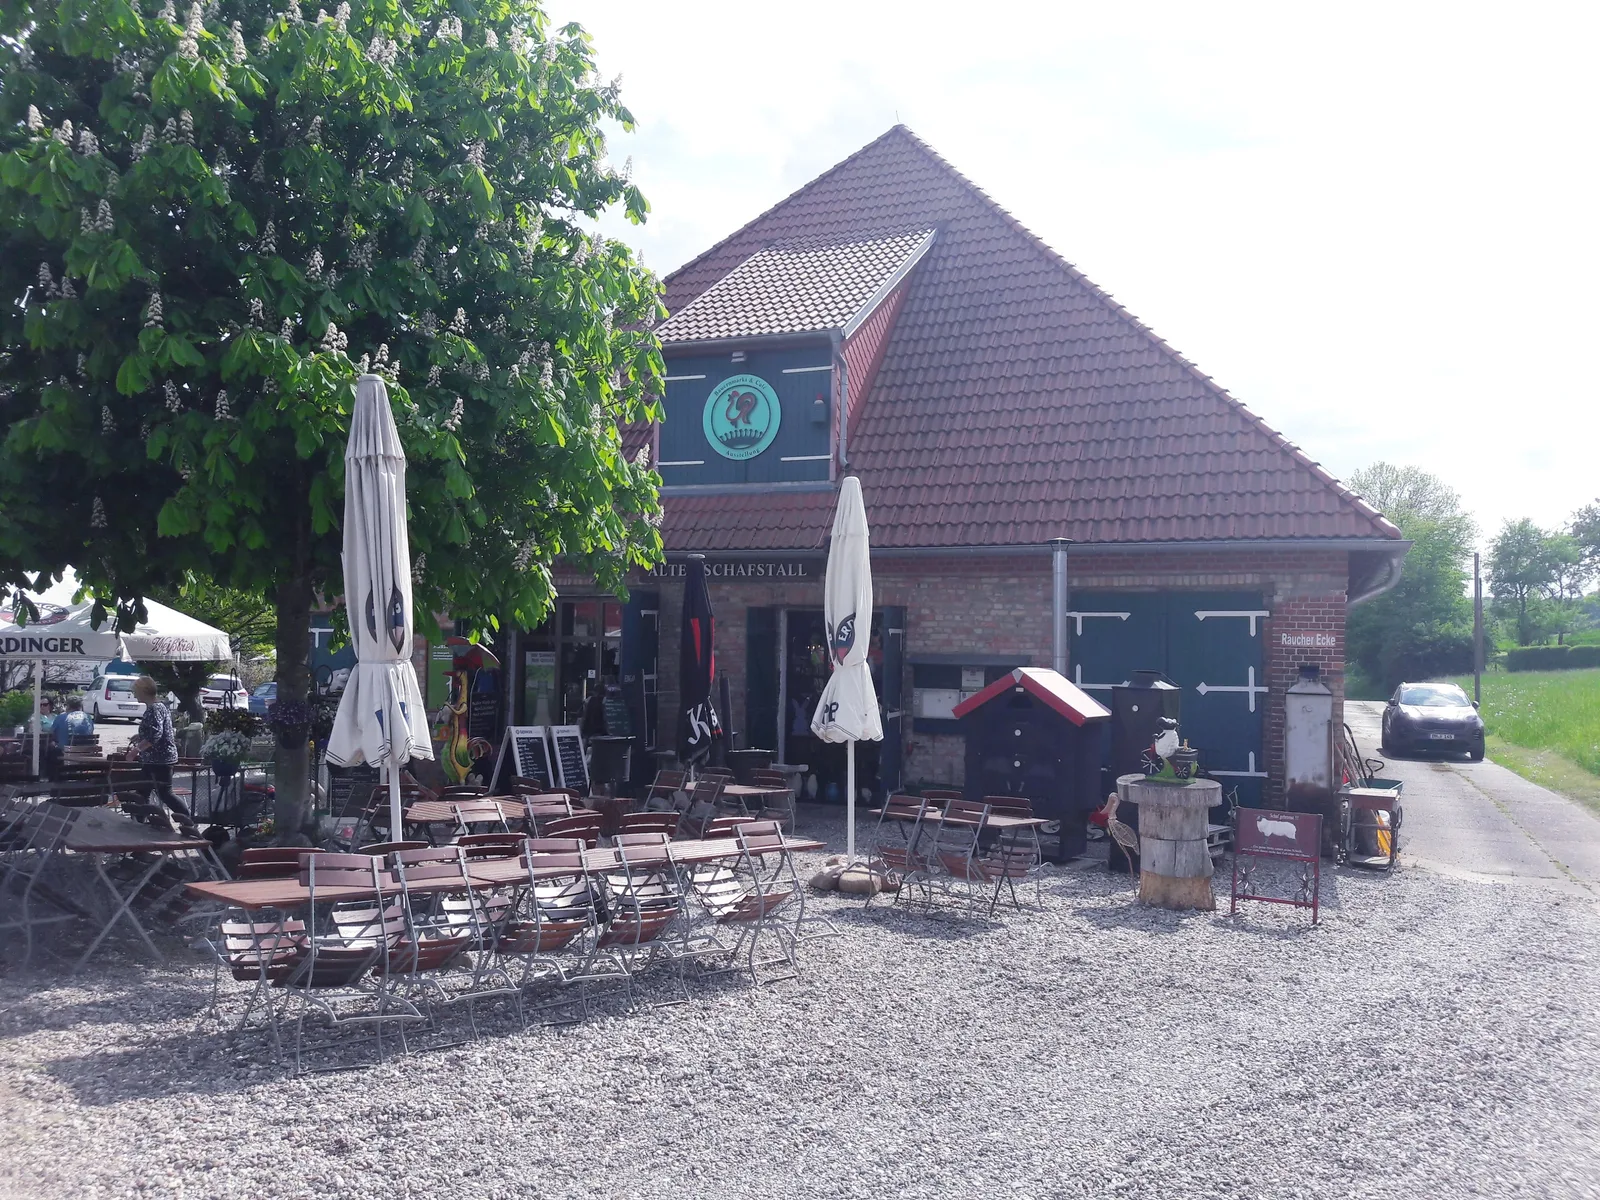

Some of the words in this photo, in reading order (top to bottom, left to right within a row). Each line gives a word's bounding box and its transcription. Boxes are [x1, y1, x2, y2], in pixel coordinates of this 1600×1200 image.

[725, 448, 761, 458] Ausstellung
[648, 563, 687, 577] ALTE
[705, 563, 808, 577] SCHAFSTALL
[1316, 633, 1336, 646] Ecke
